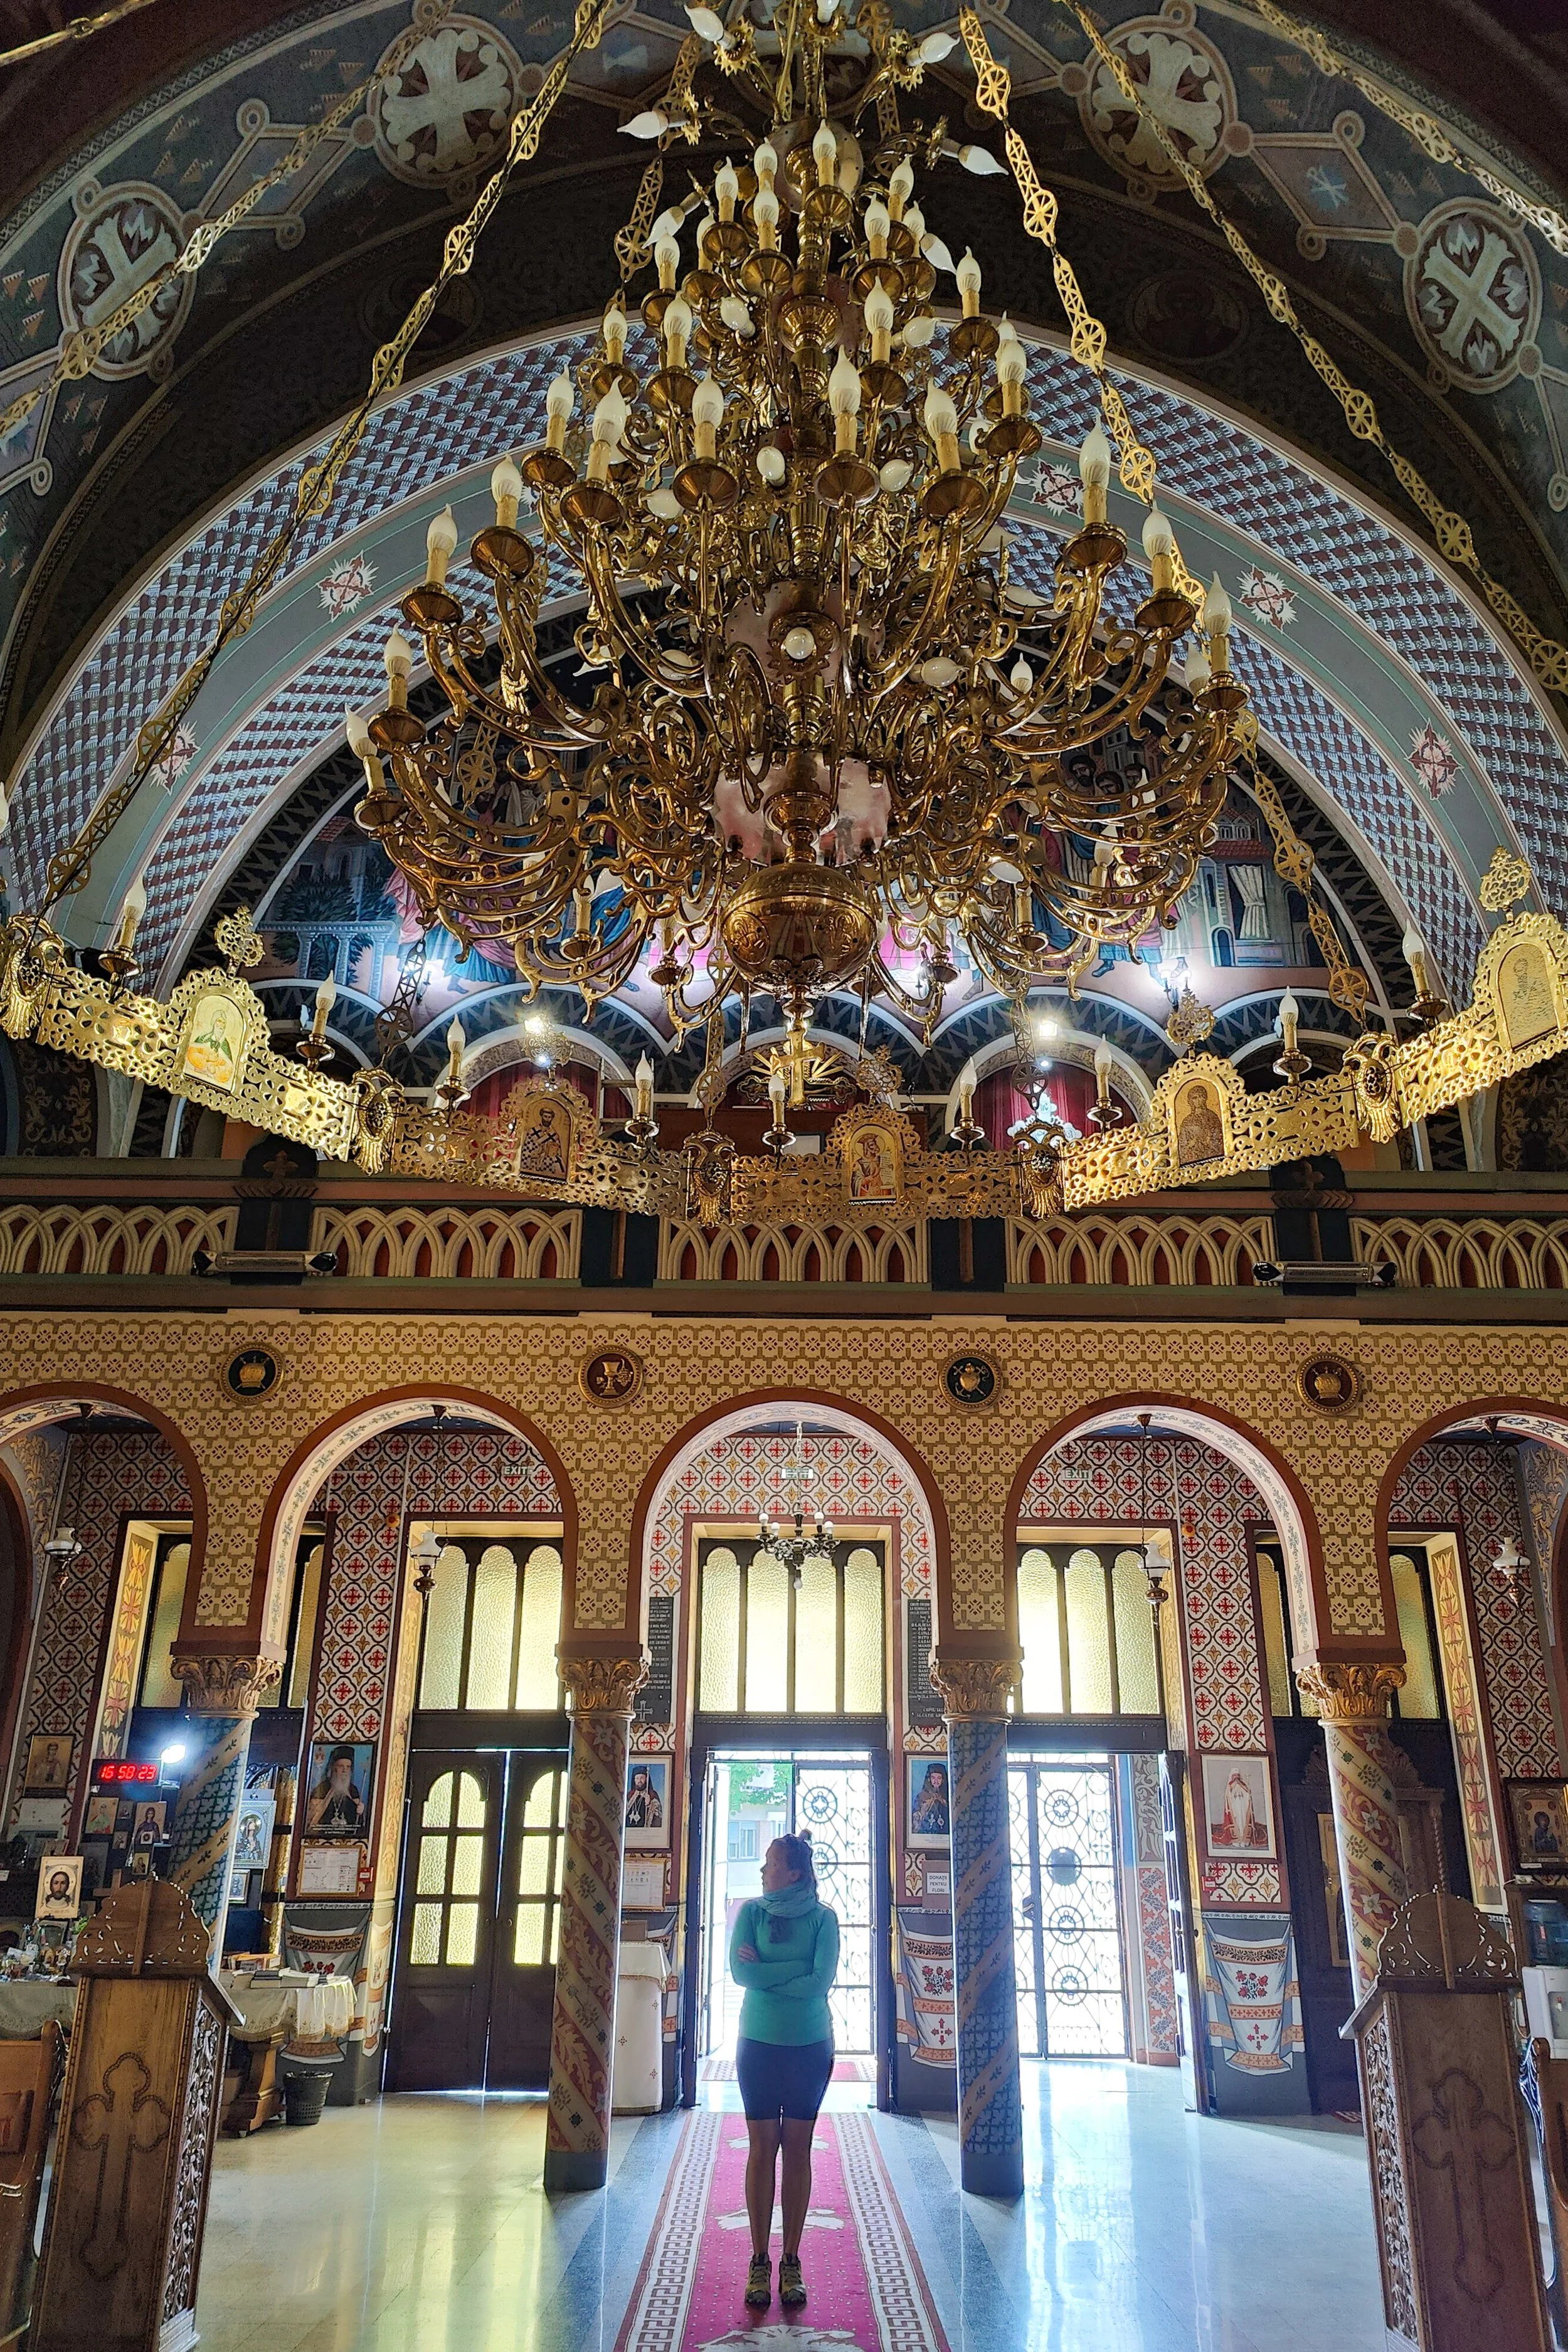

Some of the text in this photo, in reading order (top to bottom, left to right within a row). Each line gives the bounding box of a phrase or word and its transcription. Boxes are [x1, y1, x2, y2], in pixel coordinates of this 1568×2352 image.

[101, 1766, 156, 1779] 16 58 23
